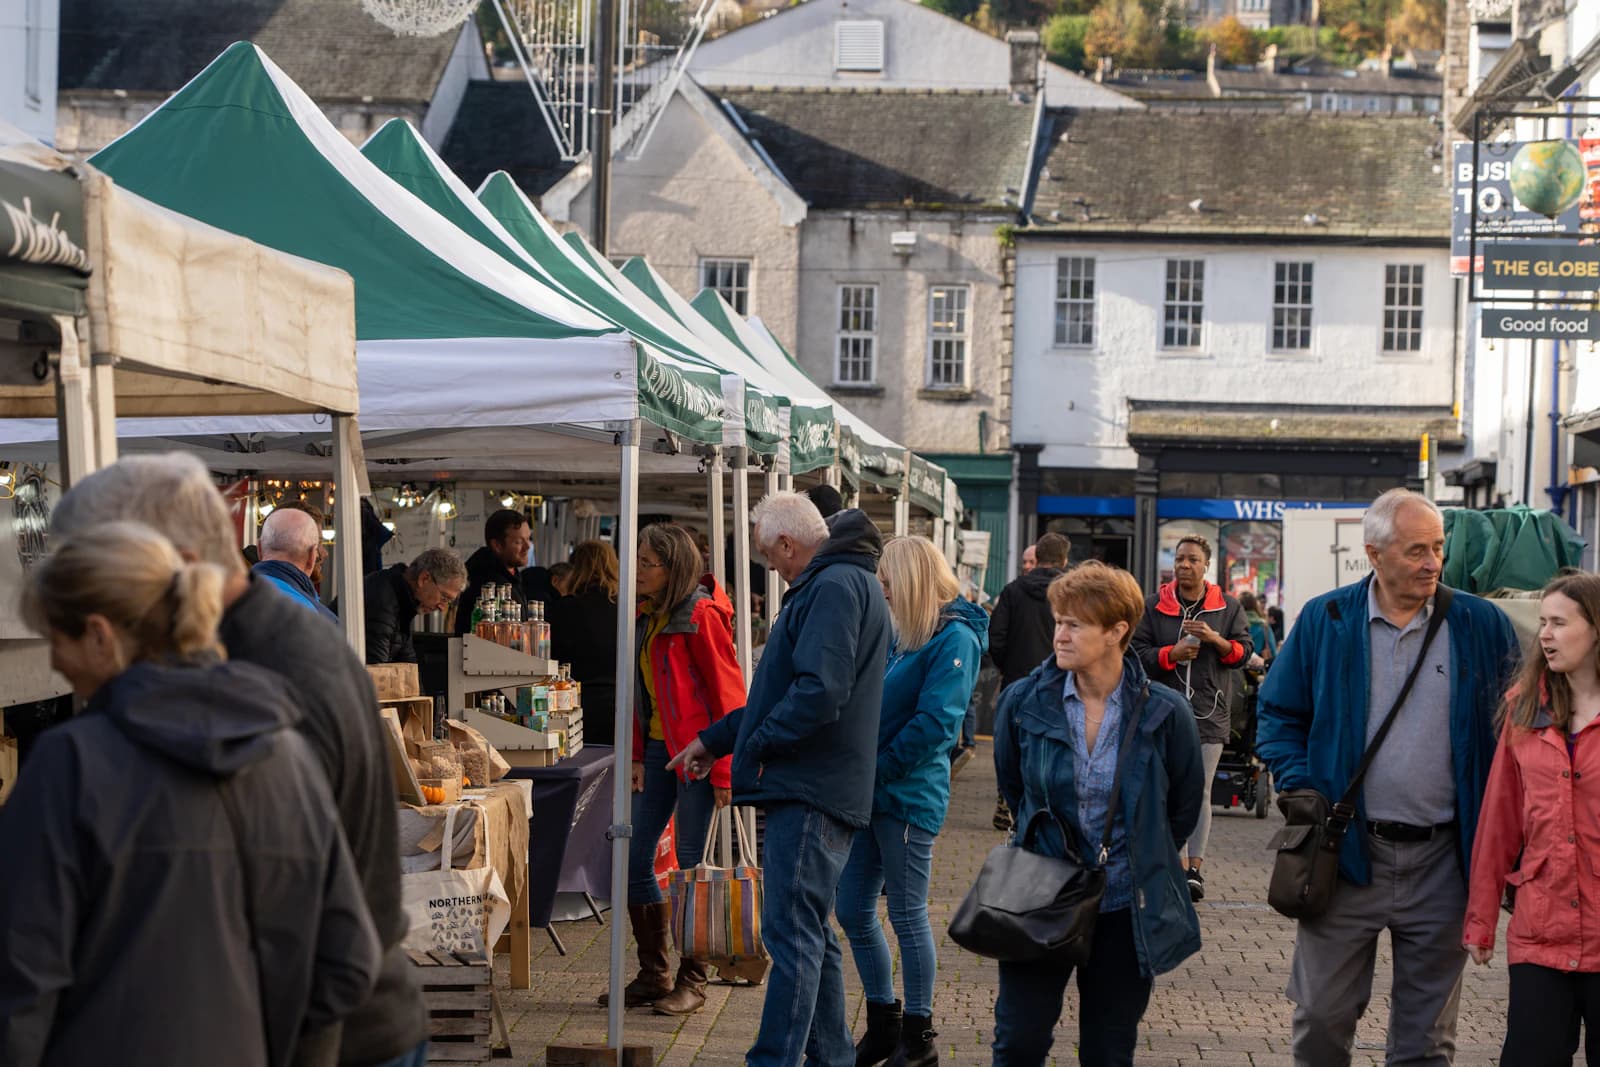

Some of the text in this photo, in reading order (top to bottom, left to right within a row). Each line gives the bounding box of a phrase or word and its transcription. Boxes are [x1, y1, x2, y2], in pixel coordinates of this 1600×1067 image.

[1457, 187, 1502, 214] TO
[1492, 259, 1600, 278] THE GLOBE
[1500, 316, 1589, 333] Good food
[429, 894, 482, 909] NORTHERN
